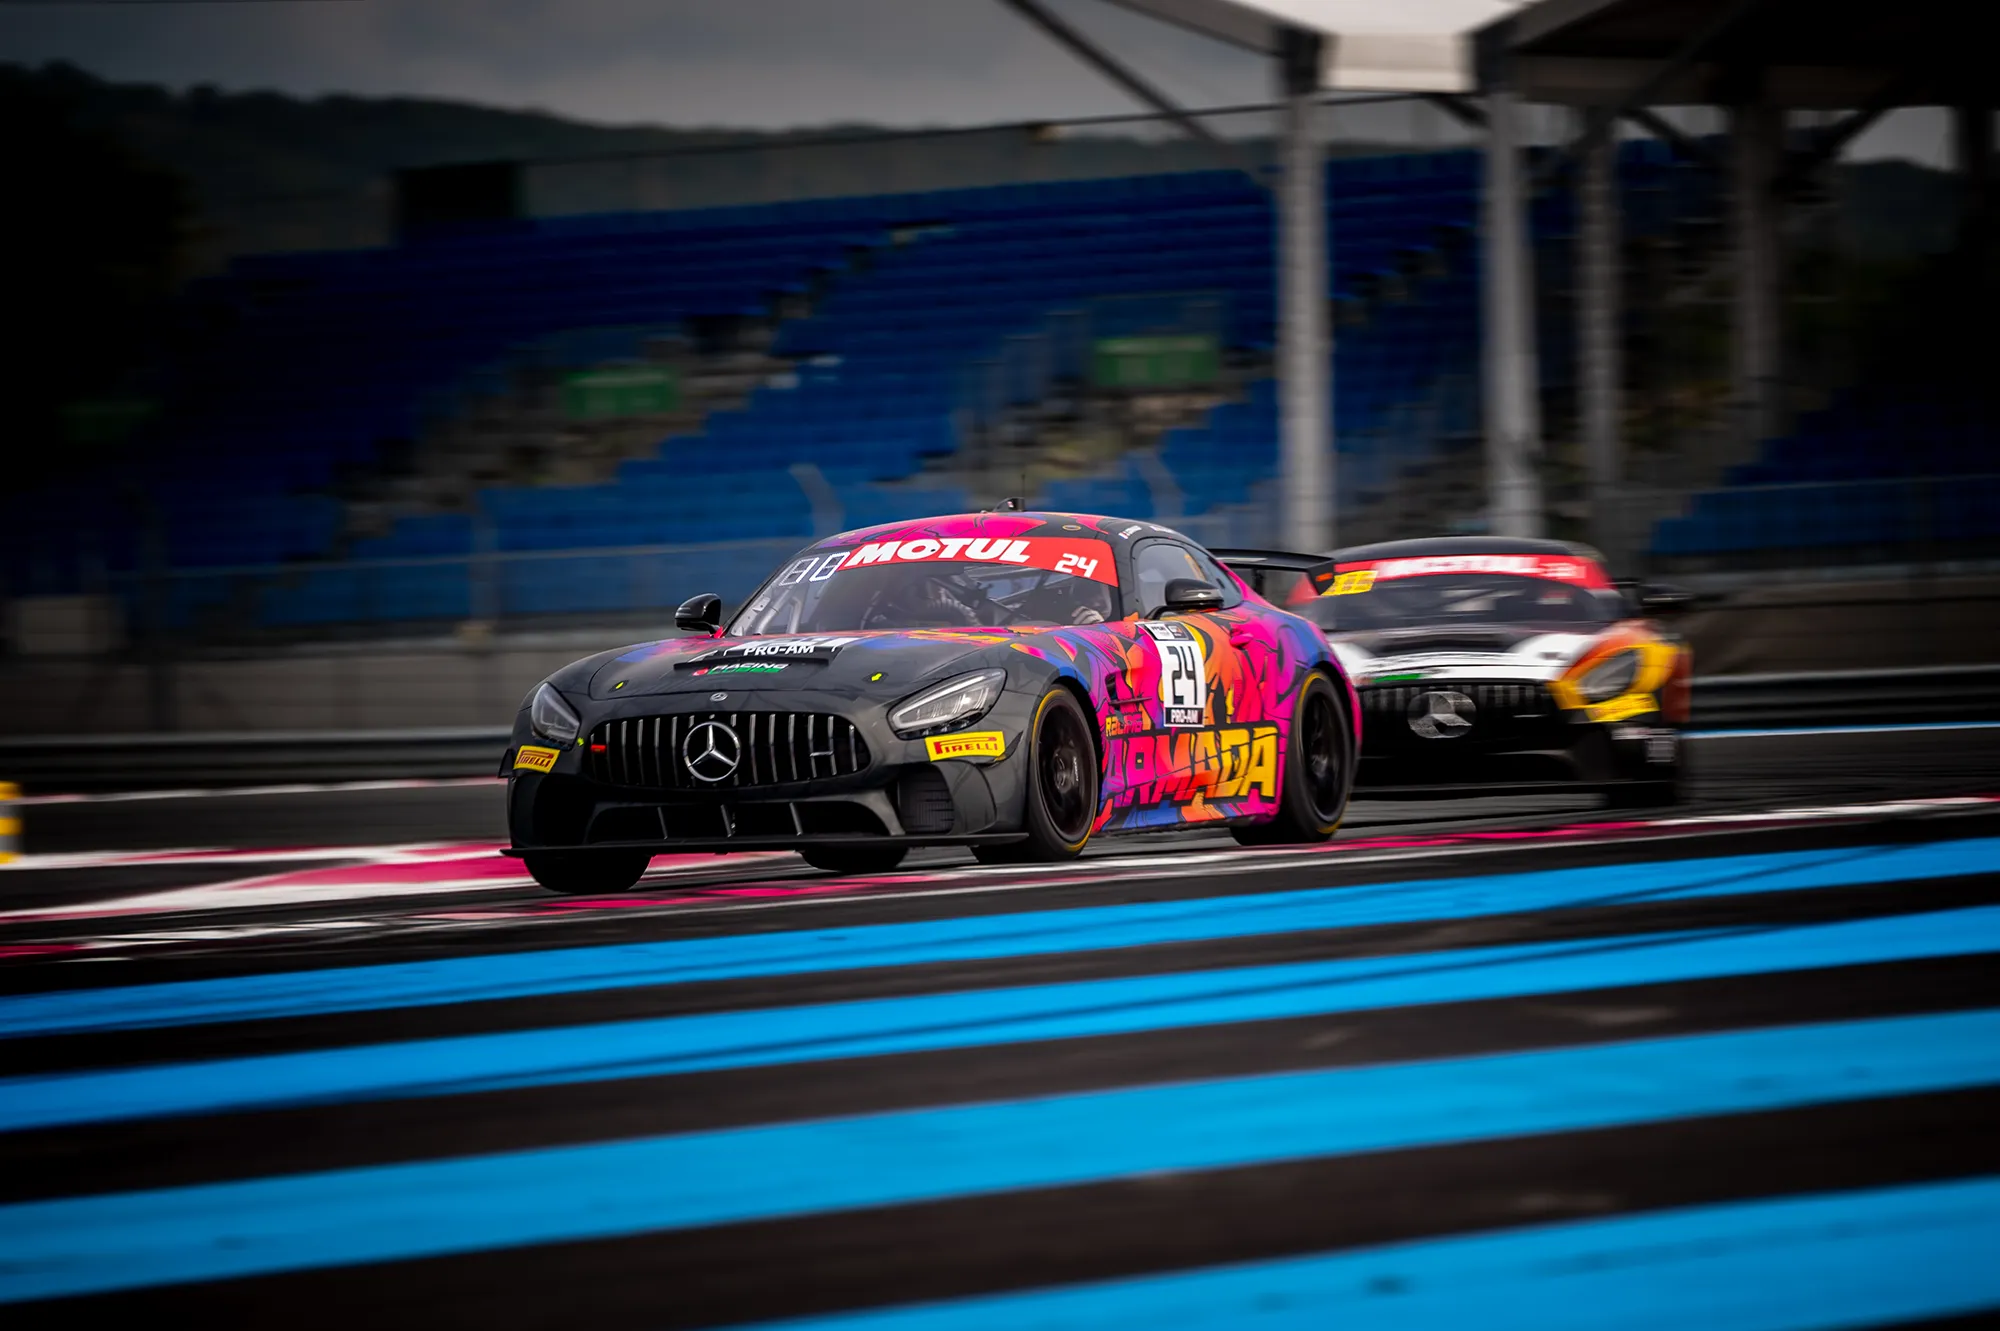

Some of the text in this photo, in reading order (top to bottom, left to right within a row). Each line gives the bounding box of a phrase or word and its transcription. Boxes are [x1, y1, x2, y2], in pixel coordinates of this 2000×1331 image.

[844, 538, 1099, 577] MOTUL 24
[743, 645, 815, 656] PRO-AM
[1166, 645, 1198, 705] 24
[1170, 709, 1199, 723] PRO-AM
[933, 737, 998, 754] PIRELLI
[515, 750, 554, 767] PIRELLI
[1102, 726, 1279, 808] ARMADA
